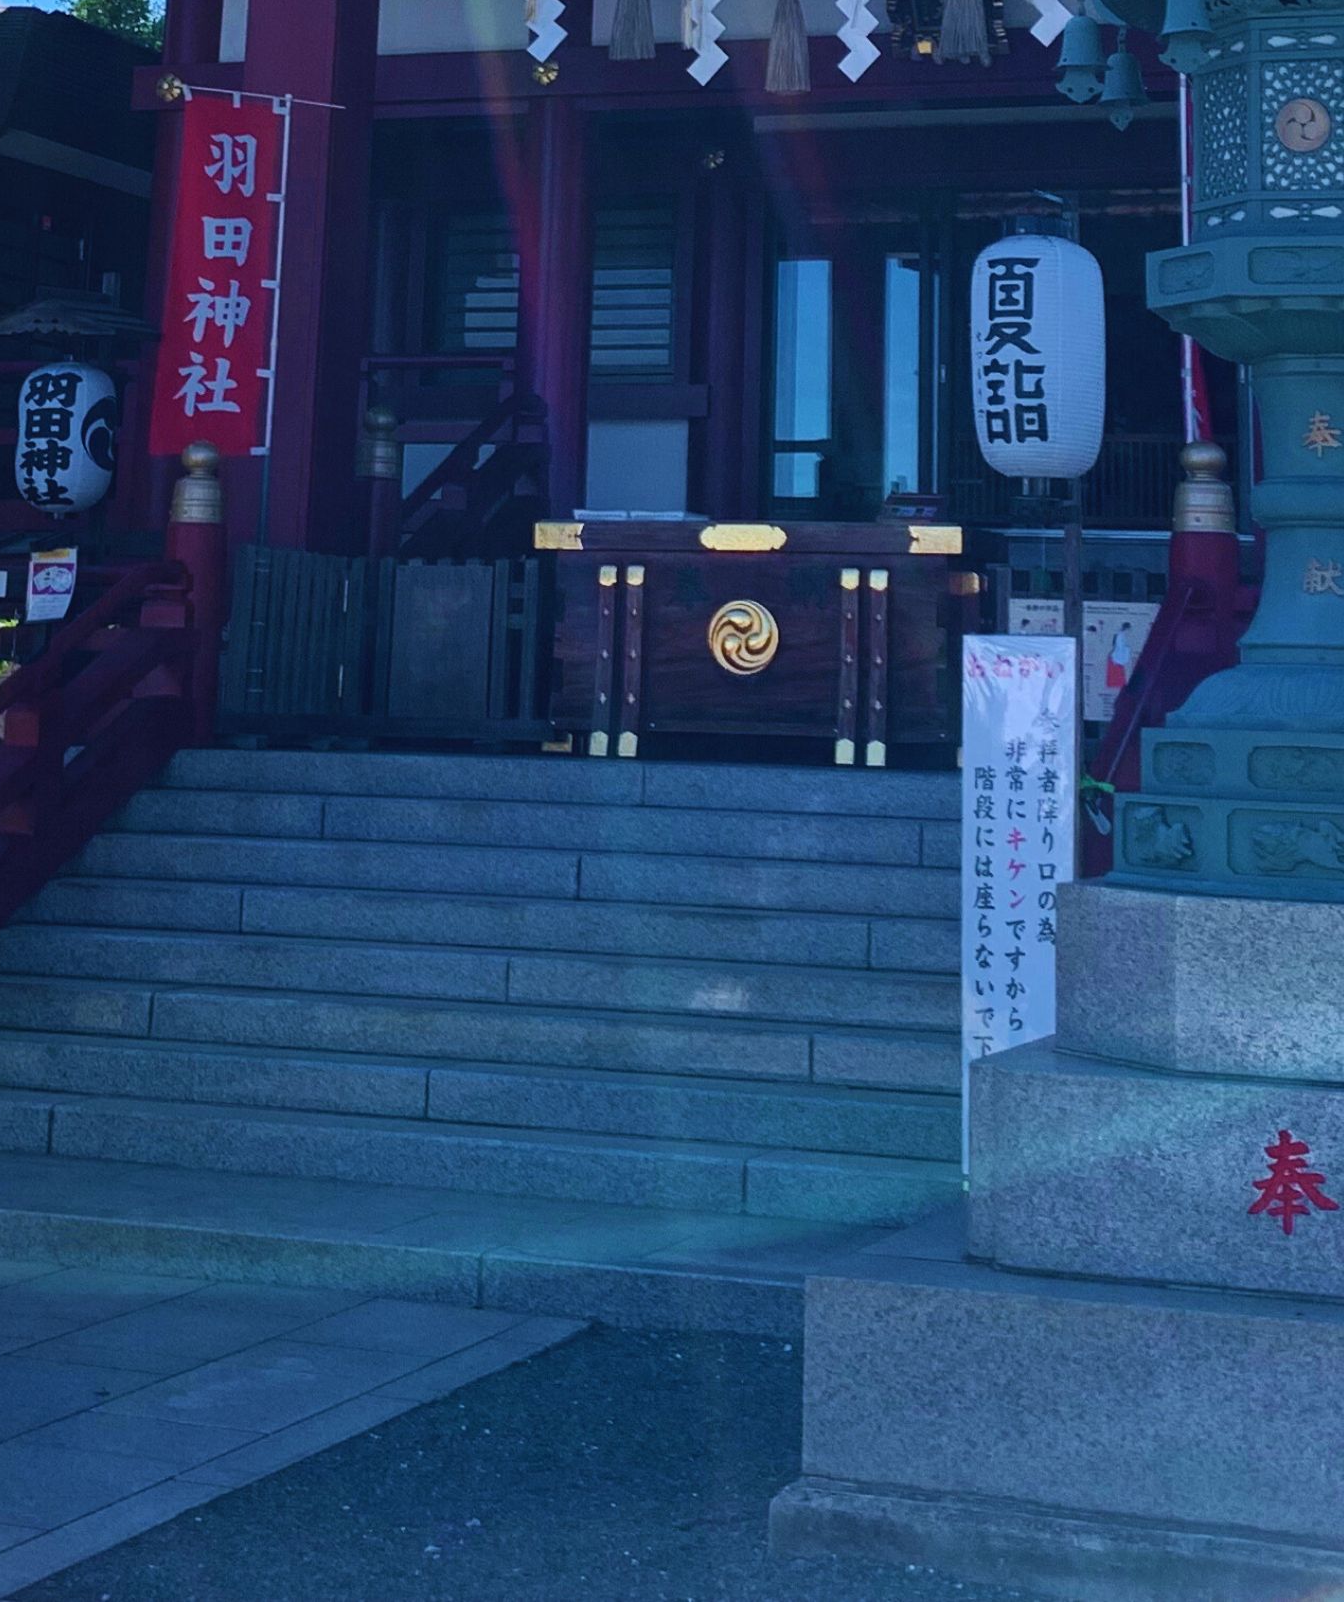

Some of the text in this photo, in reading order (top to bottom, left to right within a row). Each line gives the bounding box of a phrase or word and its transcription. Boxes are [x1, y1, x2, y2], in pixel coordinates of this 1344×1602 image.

[173, 132, 256, 419] 羽田神社
[984, 257, 1049, 444] 夏詣
[19, 373, 80, 507] 羽田神社
[1301, 409, 1343, 459] 奉
[1004, 738, 1028, 1032] 非常にキケンですから
[1247, 1130, 1341, 1236] 奉
